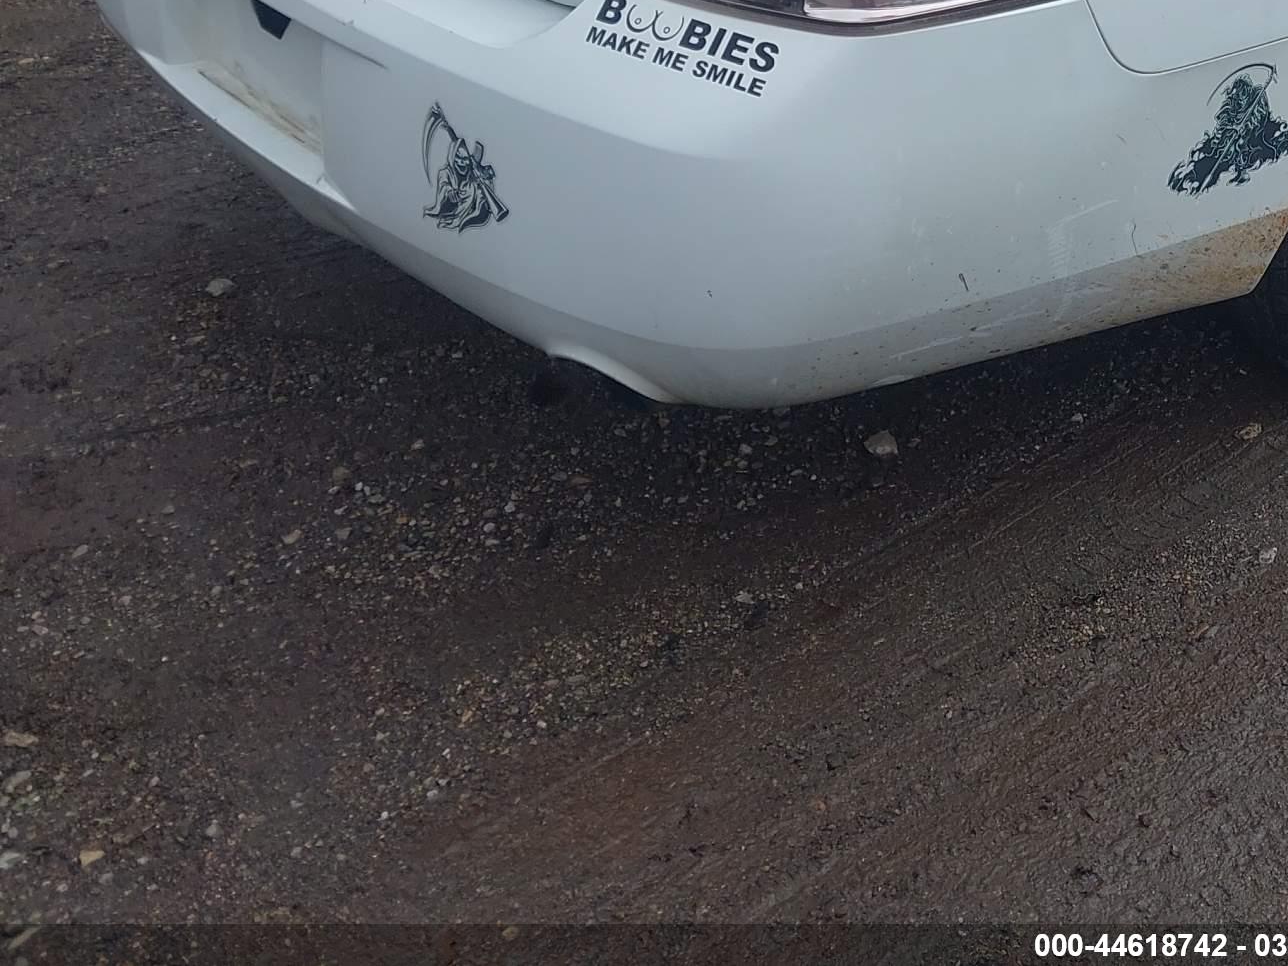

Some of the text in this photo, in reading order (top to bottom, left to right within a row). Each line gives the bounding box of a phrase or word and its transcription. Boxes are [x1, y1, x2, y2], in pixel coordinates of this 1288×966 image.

[586, 26, 767, 98] MAKE ME SMILE
